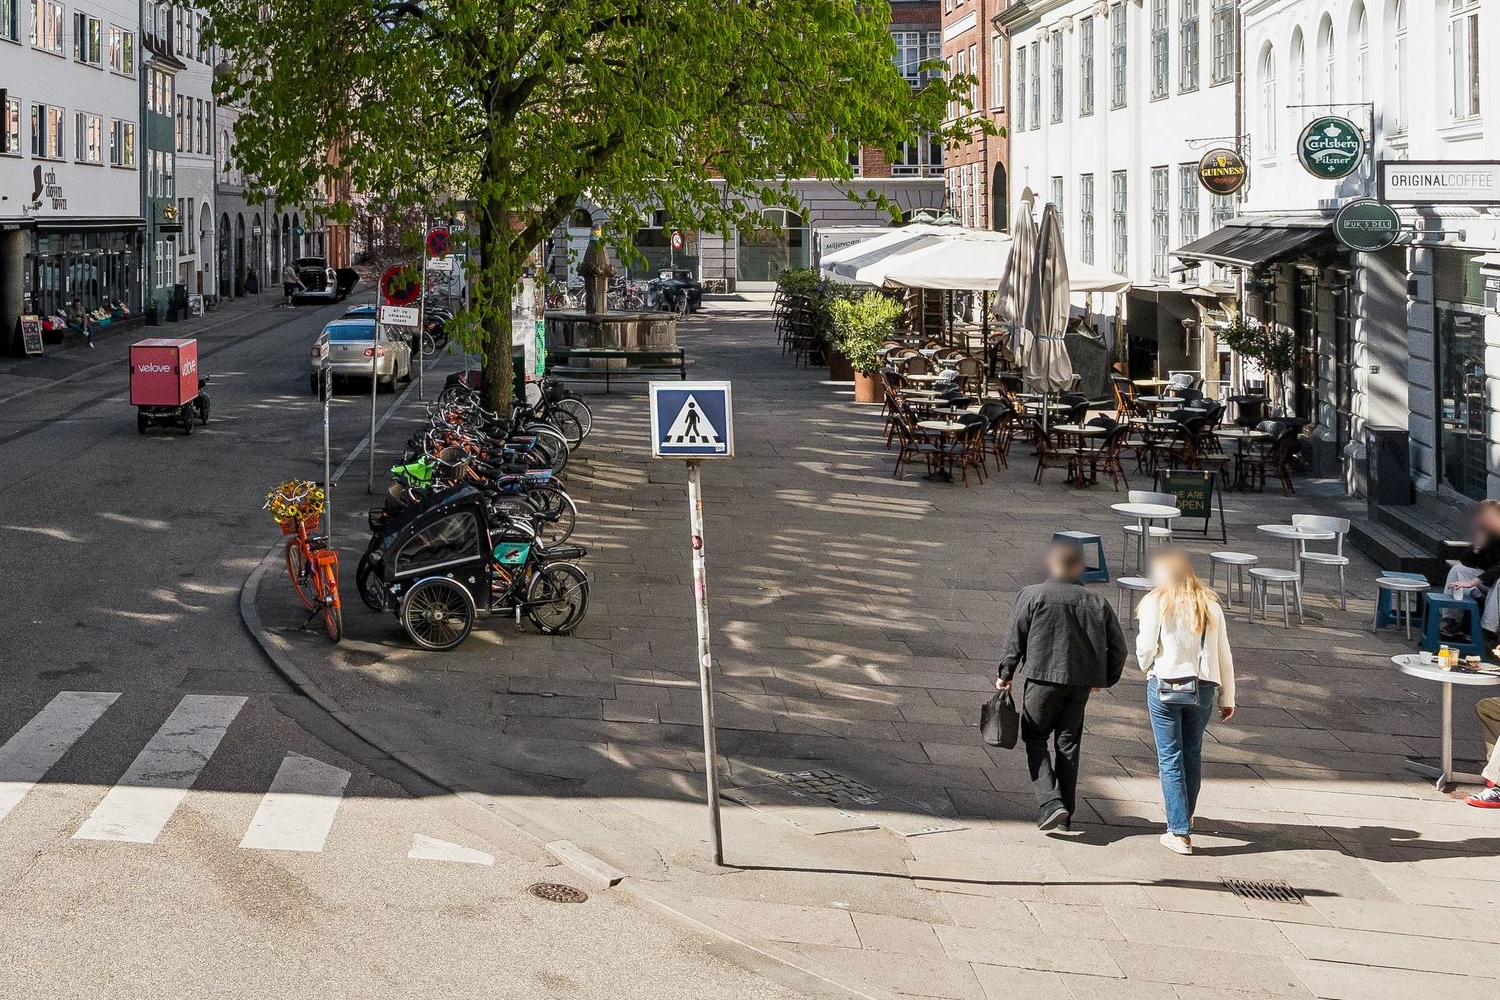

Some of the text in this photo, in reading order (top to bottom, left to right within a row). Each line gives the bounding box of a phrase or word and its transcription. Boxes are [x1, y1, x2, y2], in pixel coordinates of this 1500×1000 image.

[1305, 135, 1359, 155] Carlsberg
[1316, 156, 1350, 164] Pilsner
[1201, 167, 1244, 177] GUINNESS
[138, 362, 171, 373] velove
[1187, 491, 1205, 499] ARE
